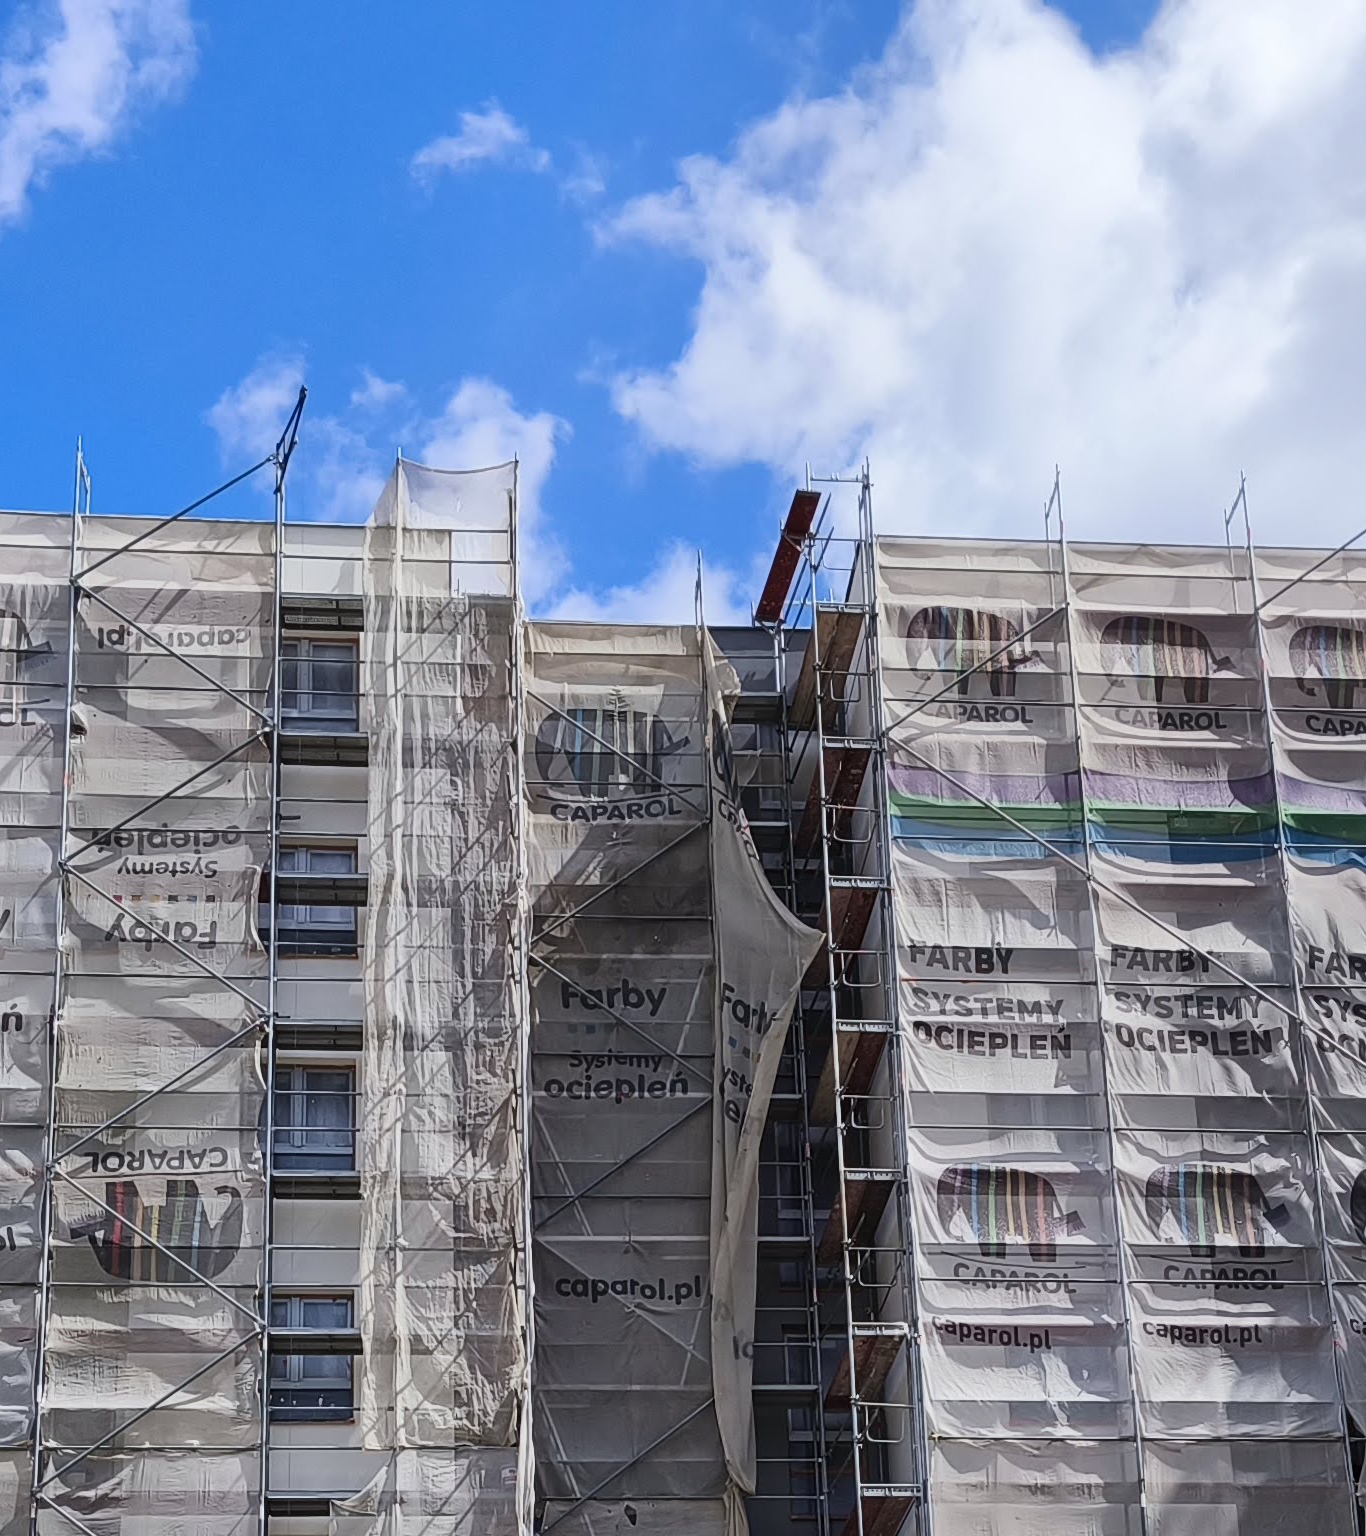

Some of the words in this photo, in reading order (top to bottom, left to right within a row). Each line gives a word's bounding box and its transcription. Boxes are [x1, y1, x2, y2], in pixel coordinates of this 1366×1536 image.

[1114, 706, 1228, 733] CAPAROL
[550, 799, 683, 824] CAPAROL
[91, 824, 242, 852] ociepleń
[117, 857, 218, 879] Systemy
[105, 913, 217, 950] Farby
[908, 944, 1015, 976] FARBY
[1109, 944, 1214, 975] FARBY
[562, 980, 667, 1019] Farby
[910, 987, 1065, 1026] SYSTEMY
[1113, 989, 1265, 1023] SYSTEMY
[911, 1020, 1073, 1061] OCIEPLEŃ
[1115, 1021, 1272, 1058] OCIEPLEŃ
[569, 1050, 664, 1075] Systemy
[544, 1072, 689, 1105] ociepleń
[91, 1147, 229, 1173] CAPAROL
[555, 1273, 702, 1306] caparol.pl
[953, 1263, 1077, 1296] CAPAROL
[1163, 1264, 1285, 1292] CAPAROL
[932, 1315, 1053, 1351] caparol.pl
[1142, 1319, 1263, 1348] caparol.pl
